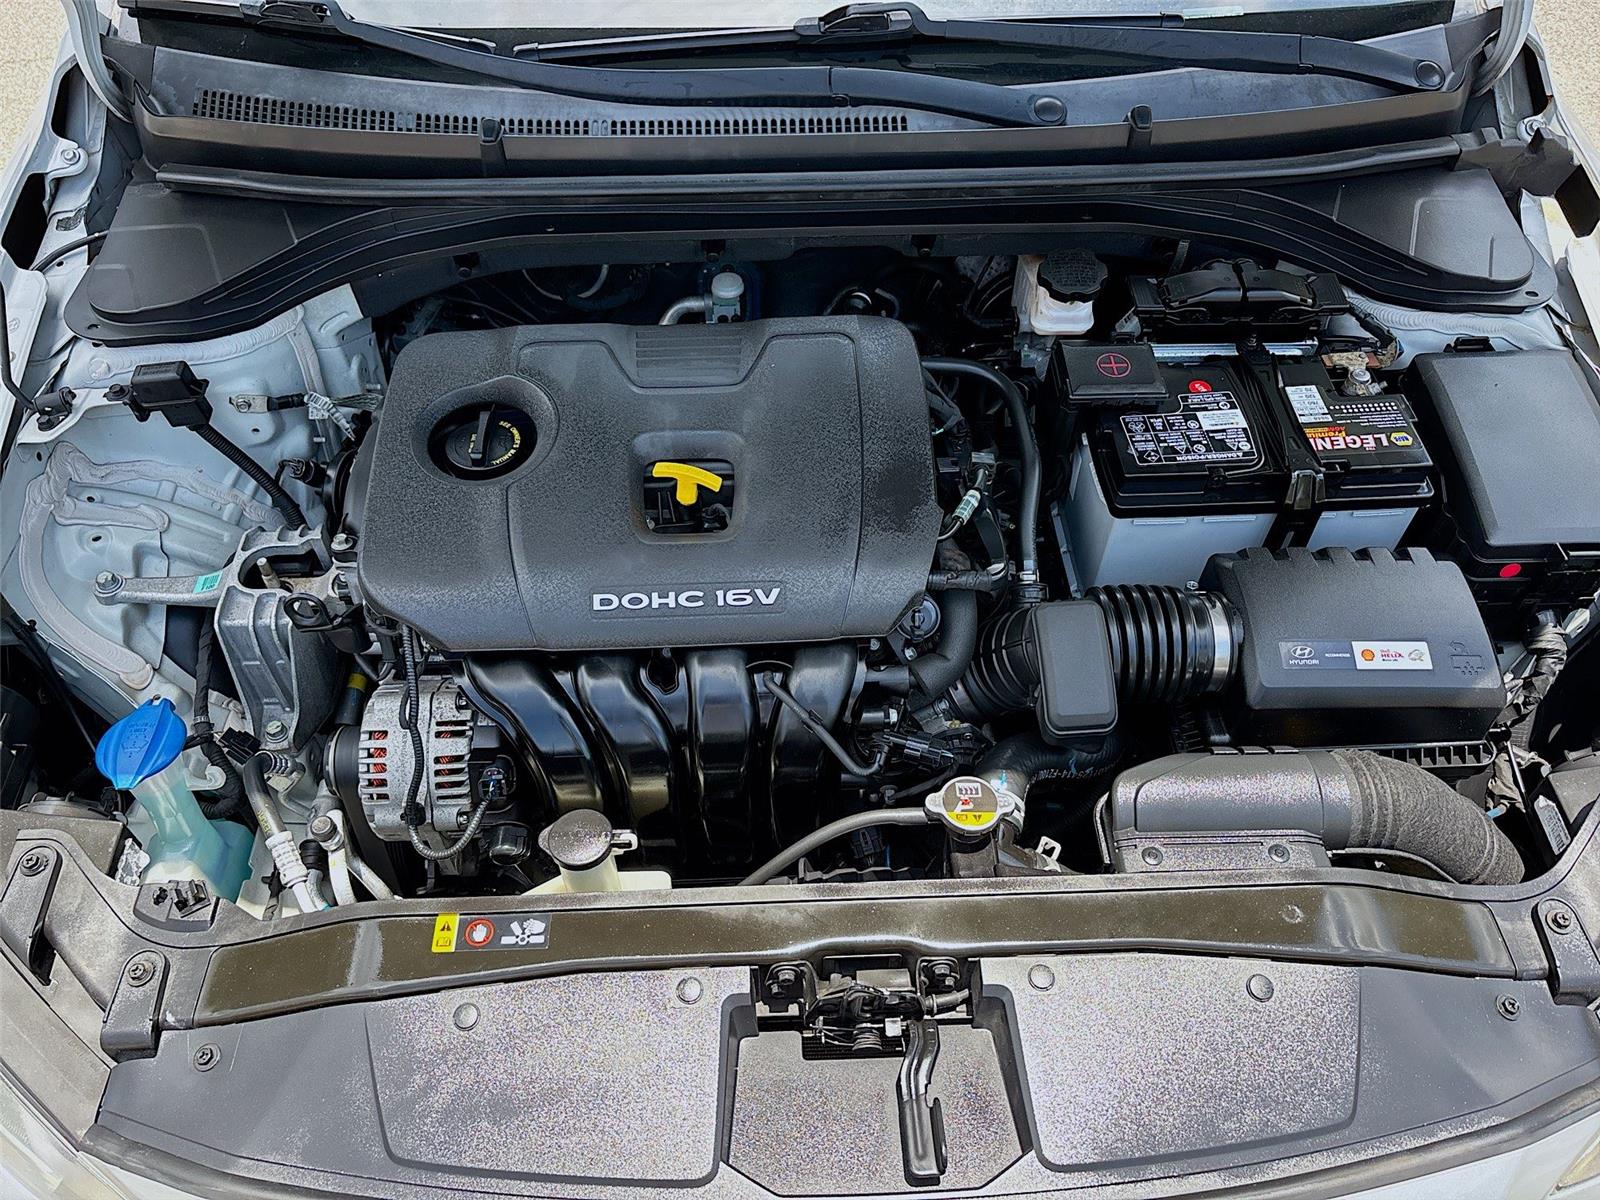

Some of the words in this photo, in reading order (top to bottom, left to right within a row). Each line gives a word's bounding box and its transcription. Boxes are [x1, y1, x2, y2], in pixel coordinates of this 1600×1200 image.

[491, 449, 516, 465] MANUAL
[592, 590, 705, 611] DOHC
[715, 587, 781, 607] 16V
